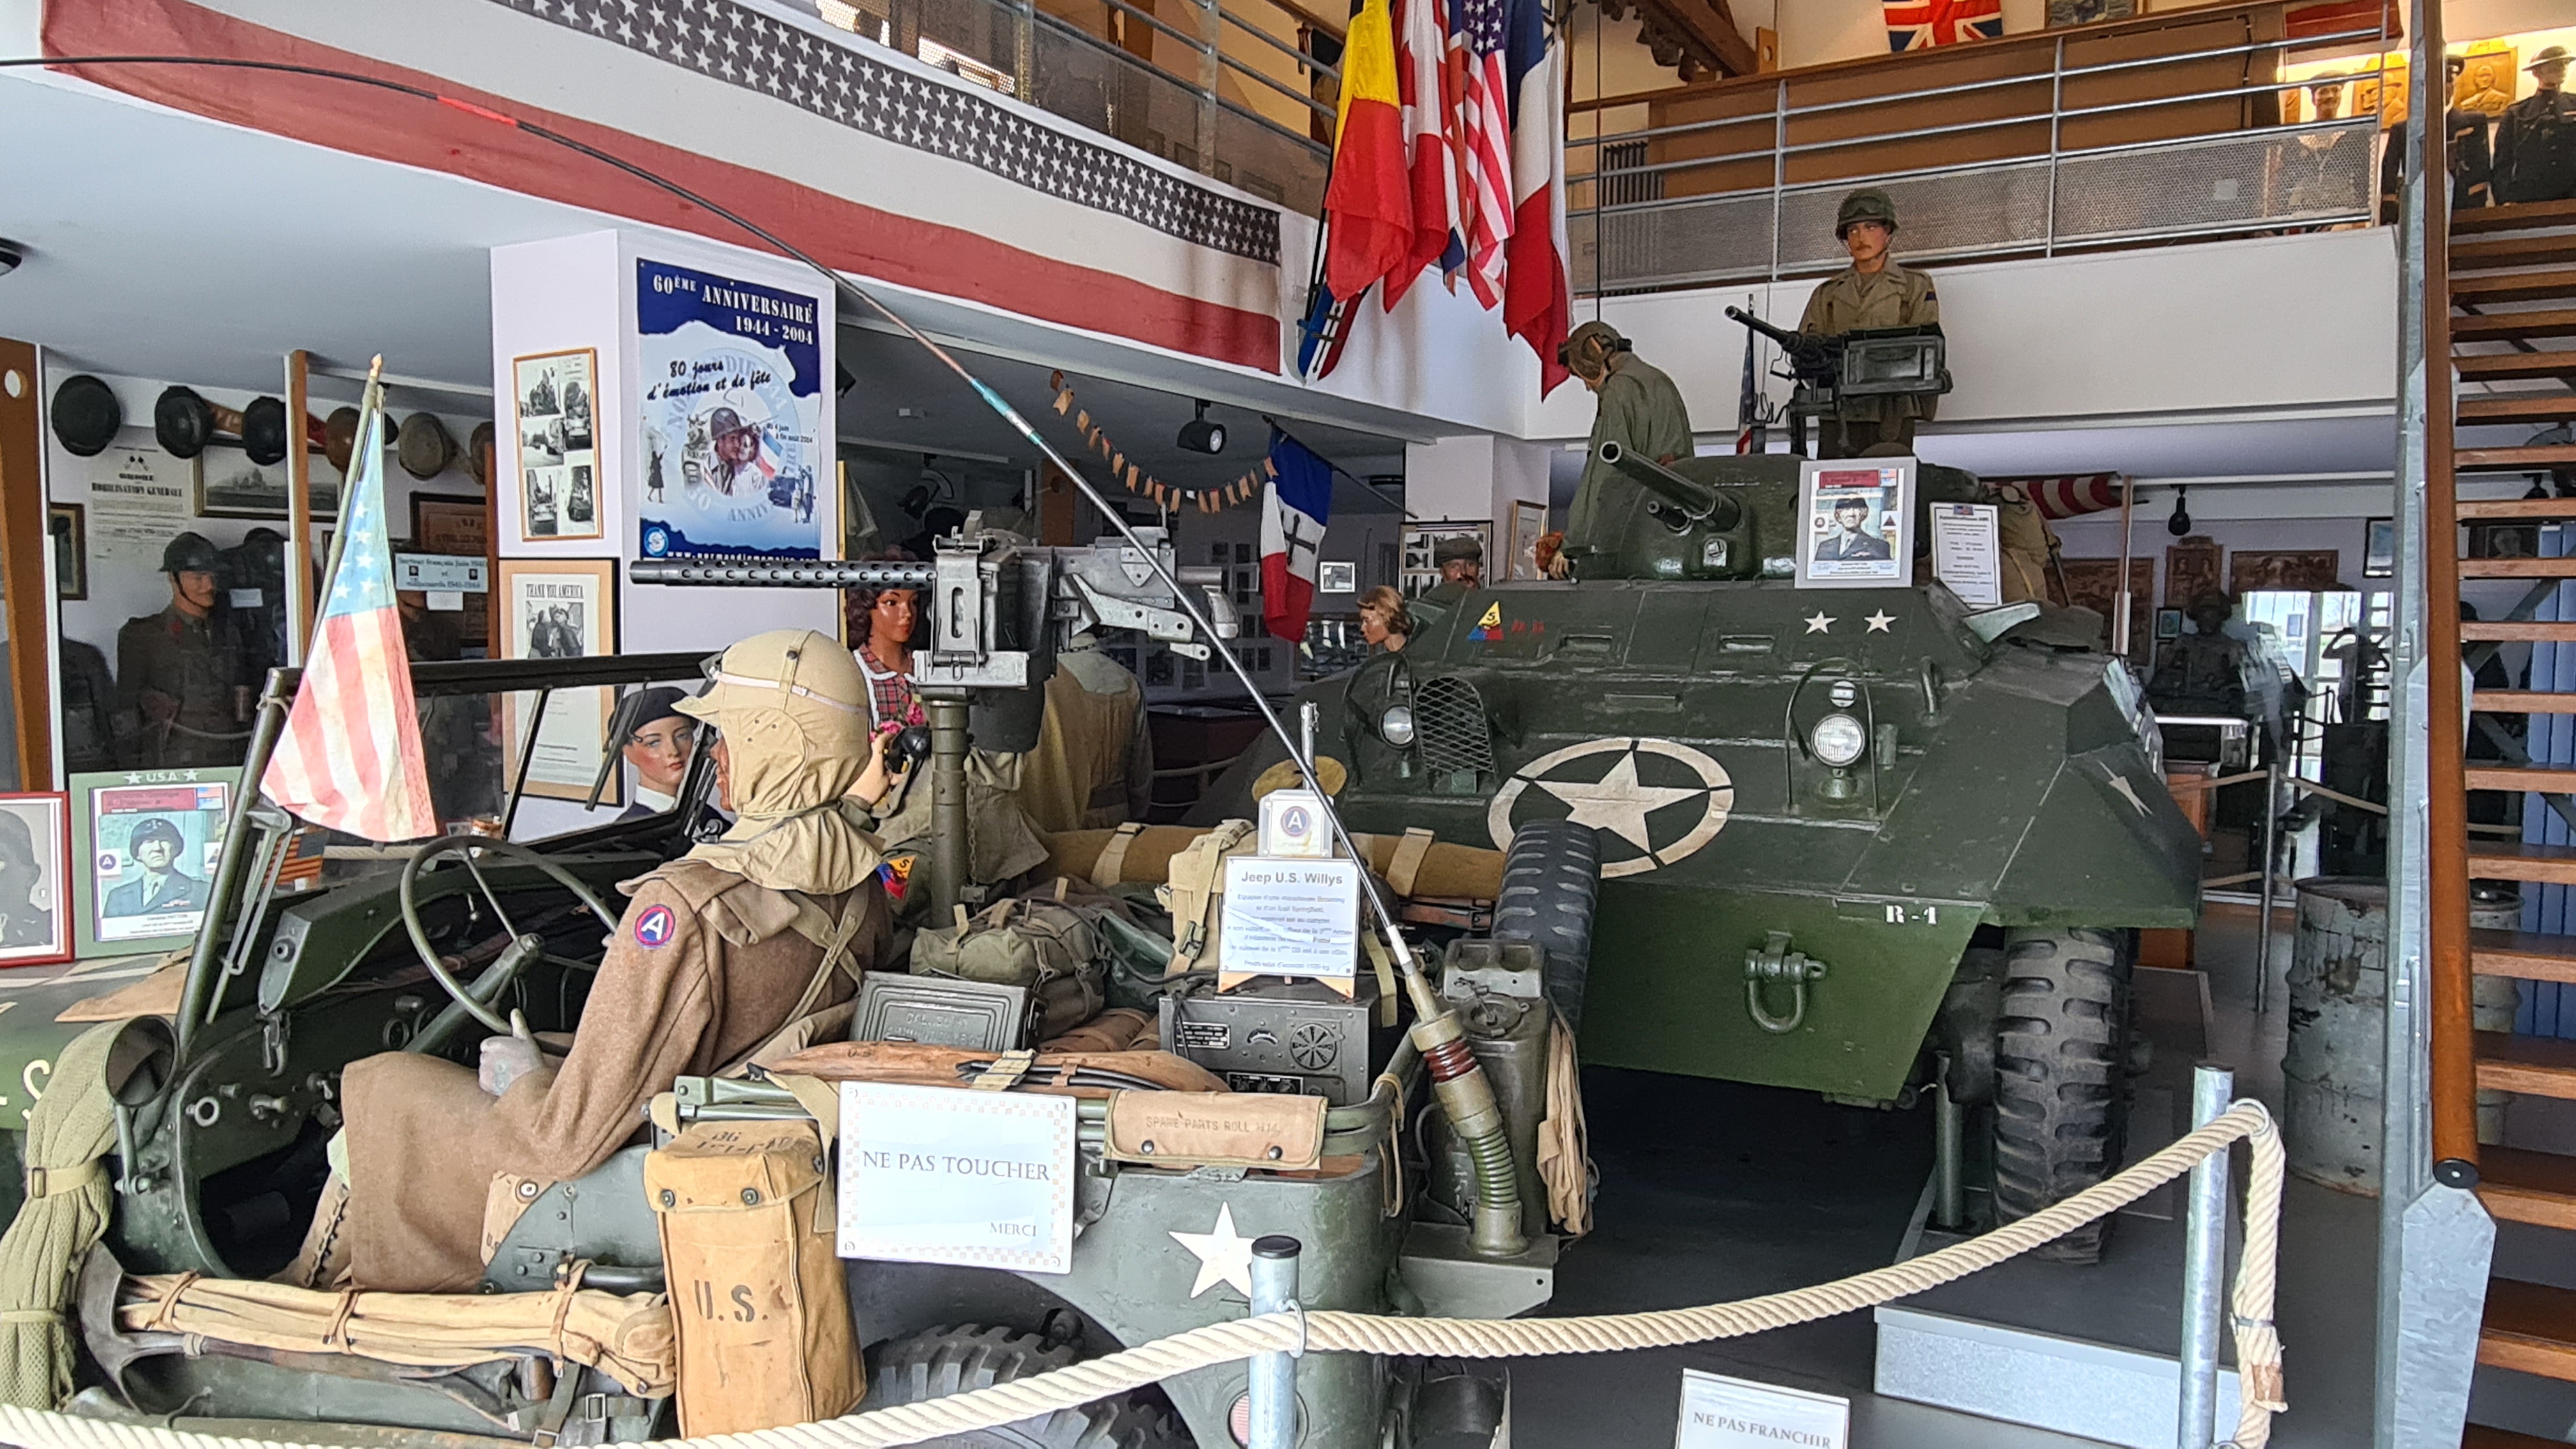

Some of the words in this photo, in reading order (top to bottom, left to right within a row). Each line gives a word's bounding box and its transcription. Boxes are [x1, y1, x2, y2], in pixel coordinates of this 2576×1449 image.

[702, 284, 813, 324] ANNIVERSAIRE
[736, 316, 770, 336] 1944
[782, 325, 813, 344] 2004
[670, 360, 687, 378] 80
[693, 360, 724, 379] jours
[716, 379, 726, 391] et
[732, 374, 745, 387] de
[750, 370, 771, 390] fête
[146, 772, 179, 783] USA
[1287, 810, 1303, 830] A
[1242, 871, 1271, 885] Jeep
[1275, 872, 1300, 884] U.S.
[1305, 873, 1343, 886] Willys
[641, 912, 665, 940] A
[1146, 1116, 1179, 1128] SPARE
[1184, 1119, 1218, 1131] PARTS
[1224, 1121, 1250, 1133] ROLL
[862, 1151, 891, 1169] NE
[899, 1153, 935, 1171] PAS
[942, 1156, 1050, 1181] TOUCHER
[990, 1222, 1036, 1237] MERCI
[694, 1280, 768, 1322] U.S.
[1693, 1412, 1715, 1427] NE
[1718, 1416, 1746, 1432] PAS
[1749, 1423, 1831, 1449] FRANCHIR
